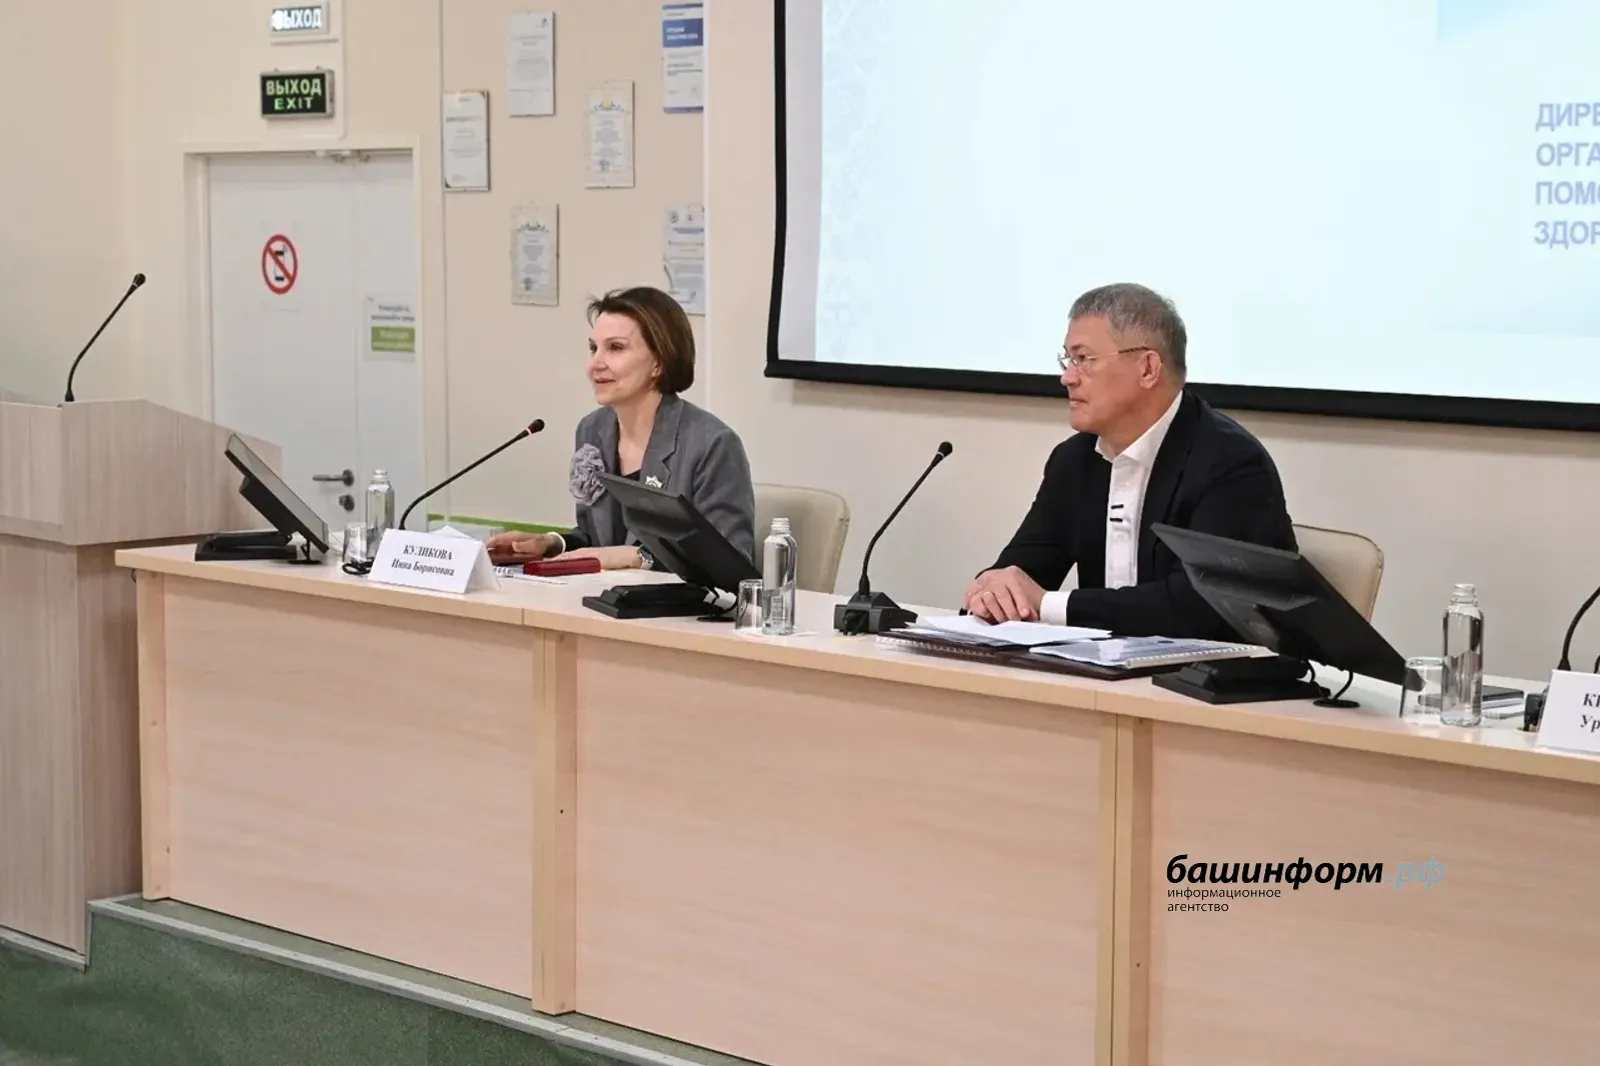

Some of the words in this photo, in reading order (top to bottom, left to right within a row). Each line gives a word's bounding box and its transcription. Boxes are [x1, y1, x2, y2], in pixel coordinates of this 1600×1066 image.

[271, 8, 322, 30] ЫХОД
[265, 78, 322, 96] ВЫХОД
[274, 97, 313, 110] EXIT
[1535, 142, 1600, 167] ОРГА
[1535, 180, 1600, 206] ПОМ
[1534, 220, 1600, 250] ЗДОР
[403, 544, 453, 560] КУЛИКОВА
[413, 561, 455, 576] Борисовна
[1583, 693, 1600, 707] К
